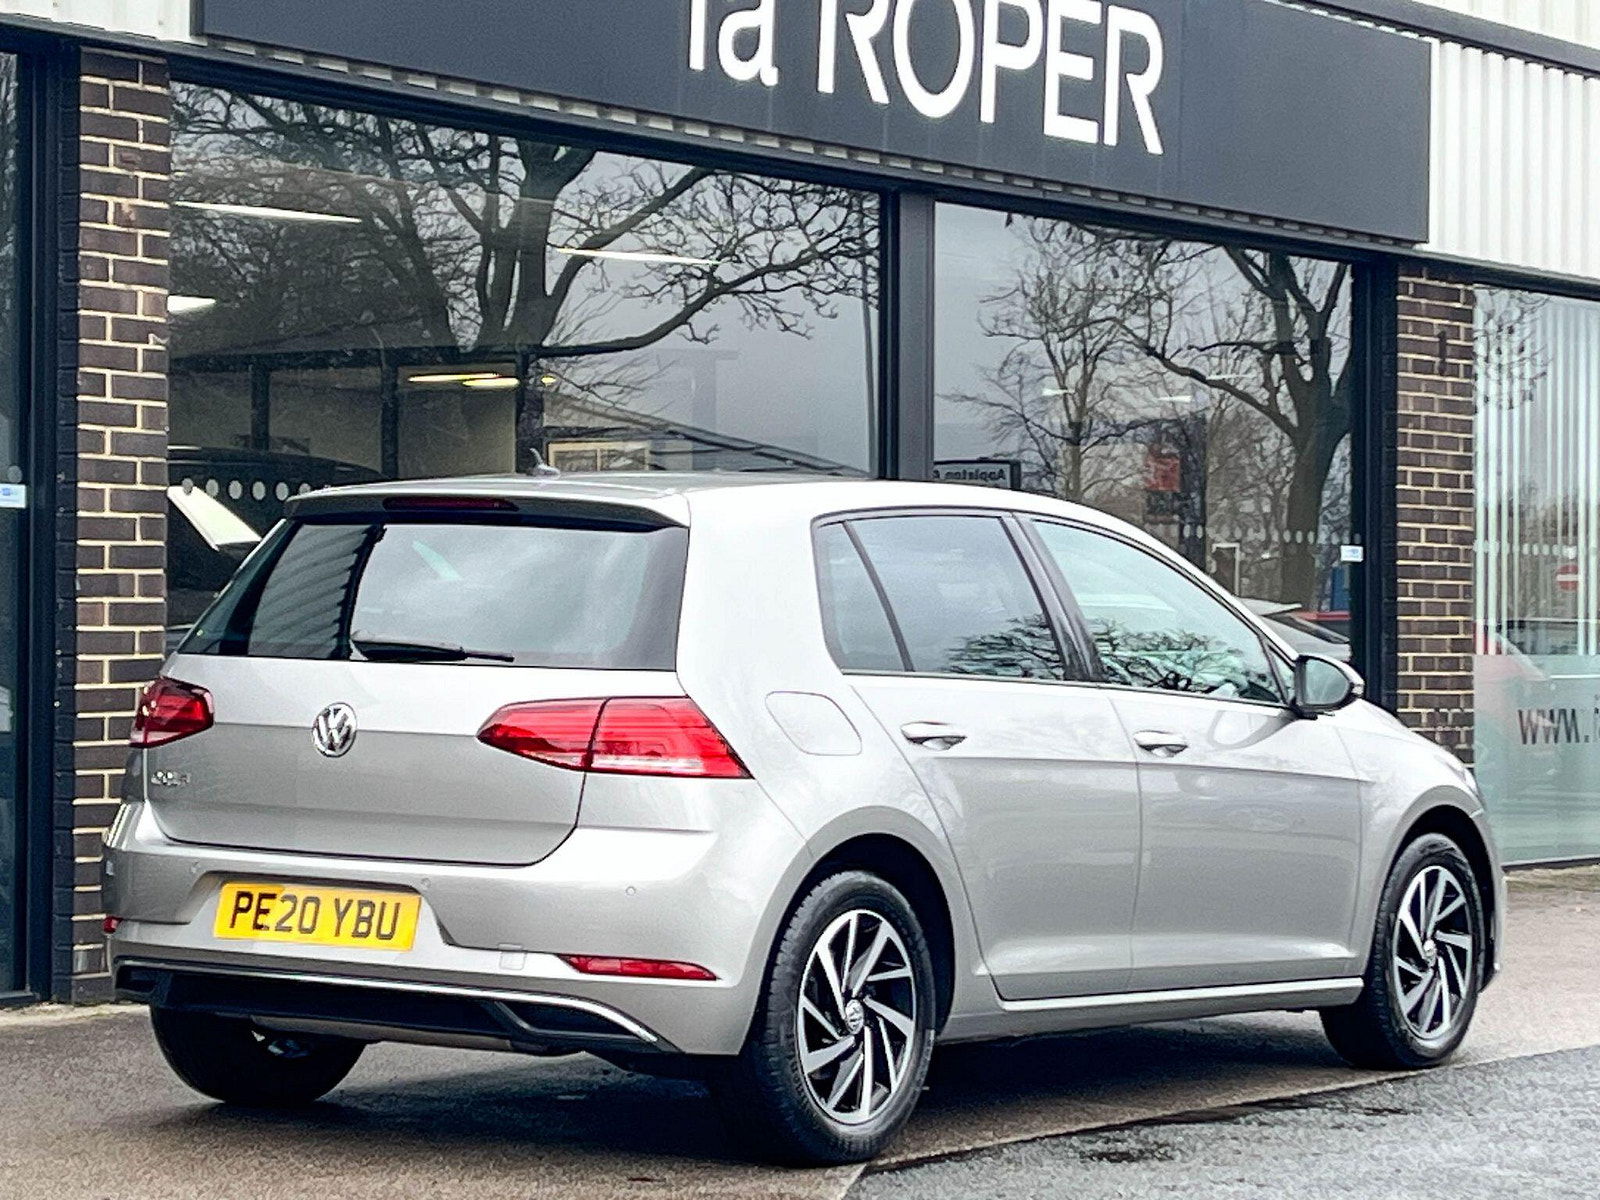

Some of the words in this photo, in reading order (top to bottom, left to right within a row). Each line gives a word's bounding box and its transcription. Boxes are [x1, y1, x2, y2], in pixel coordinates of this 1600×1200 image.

[817, 0, 1164, 155] ROPER
[229, 890, 321, 935] PE20
[334, 897, 401, 941] YBU
